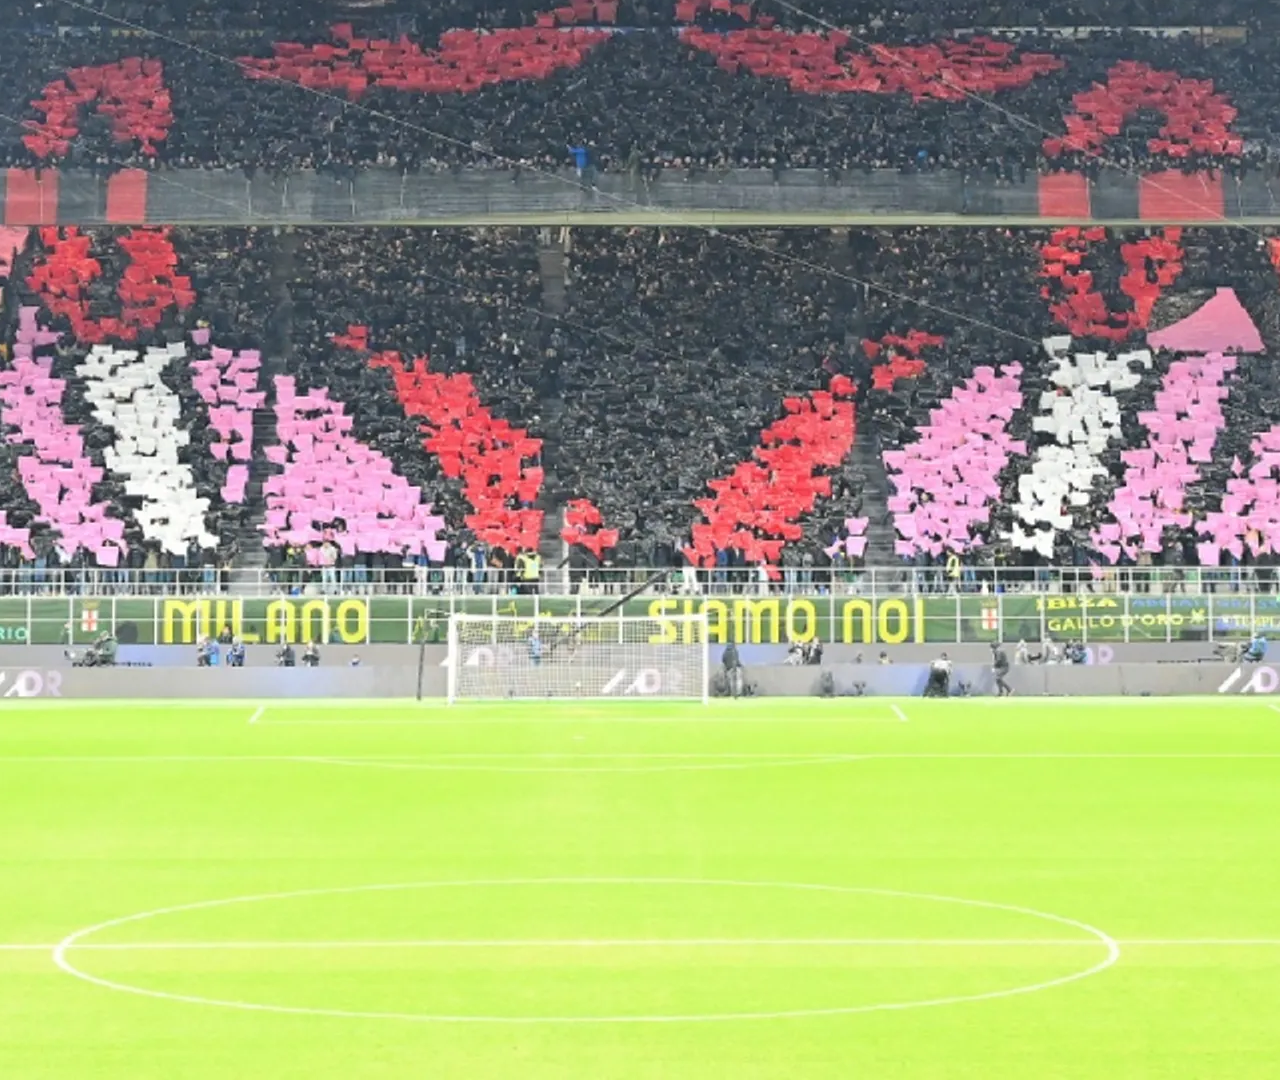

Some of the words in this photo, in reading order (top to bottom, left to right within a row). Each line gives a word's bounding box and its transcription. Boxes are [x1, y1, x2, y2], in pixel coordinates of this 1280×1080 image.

[1036, 596, 1119, 611] IBIZA
[162, 598, 368, 644] MILANO
[648, 598, 816, 644] SIAMO
[843, 598, 924, 644] NOI
[1048, 614, 1115, 631] GALLO
[1122, 612, 1184, 626] D'ORO
